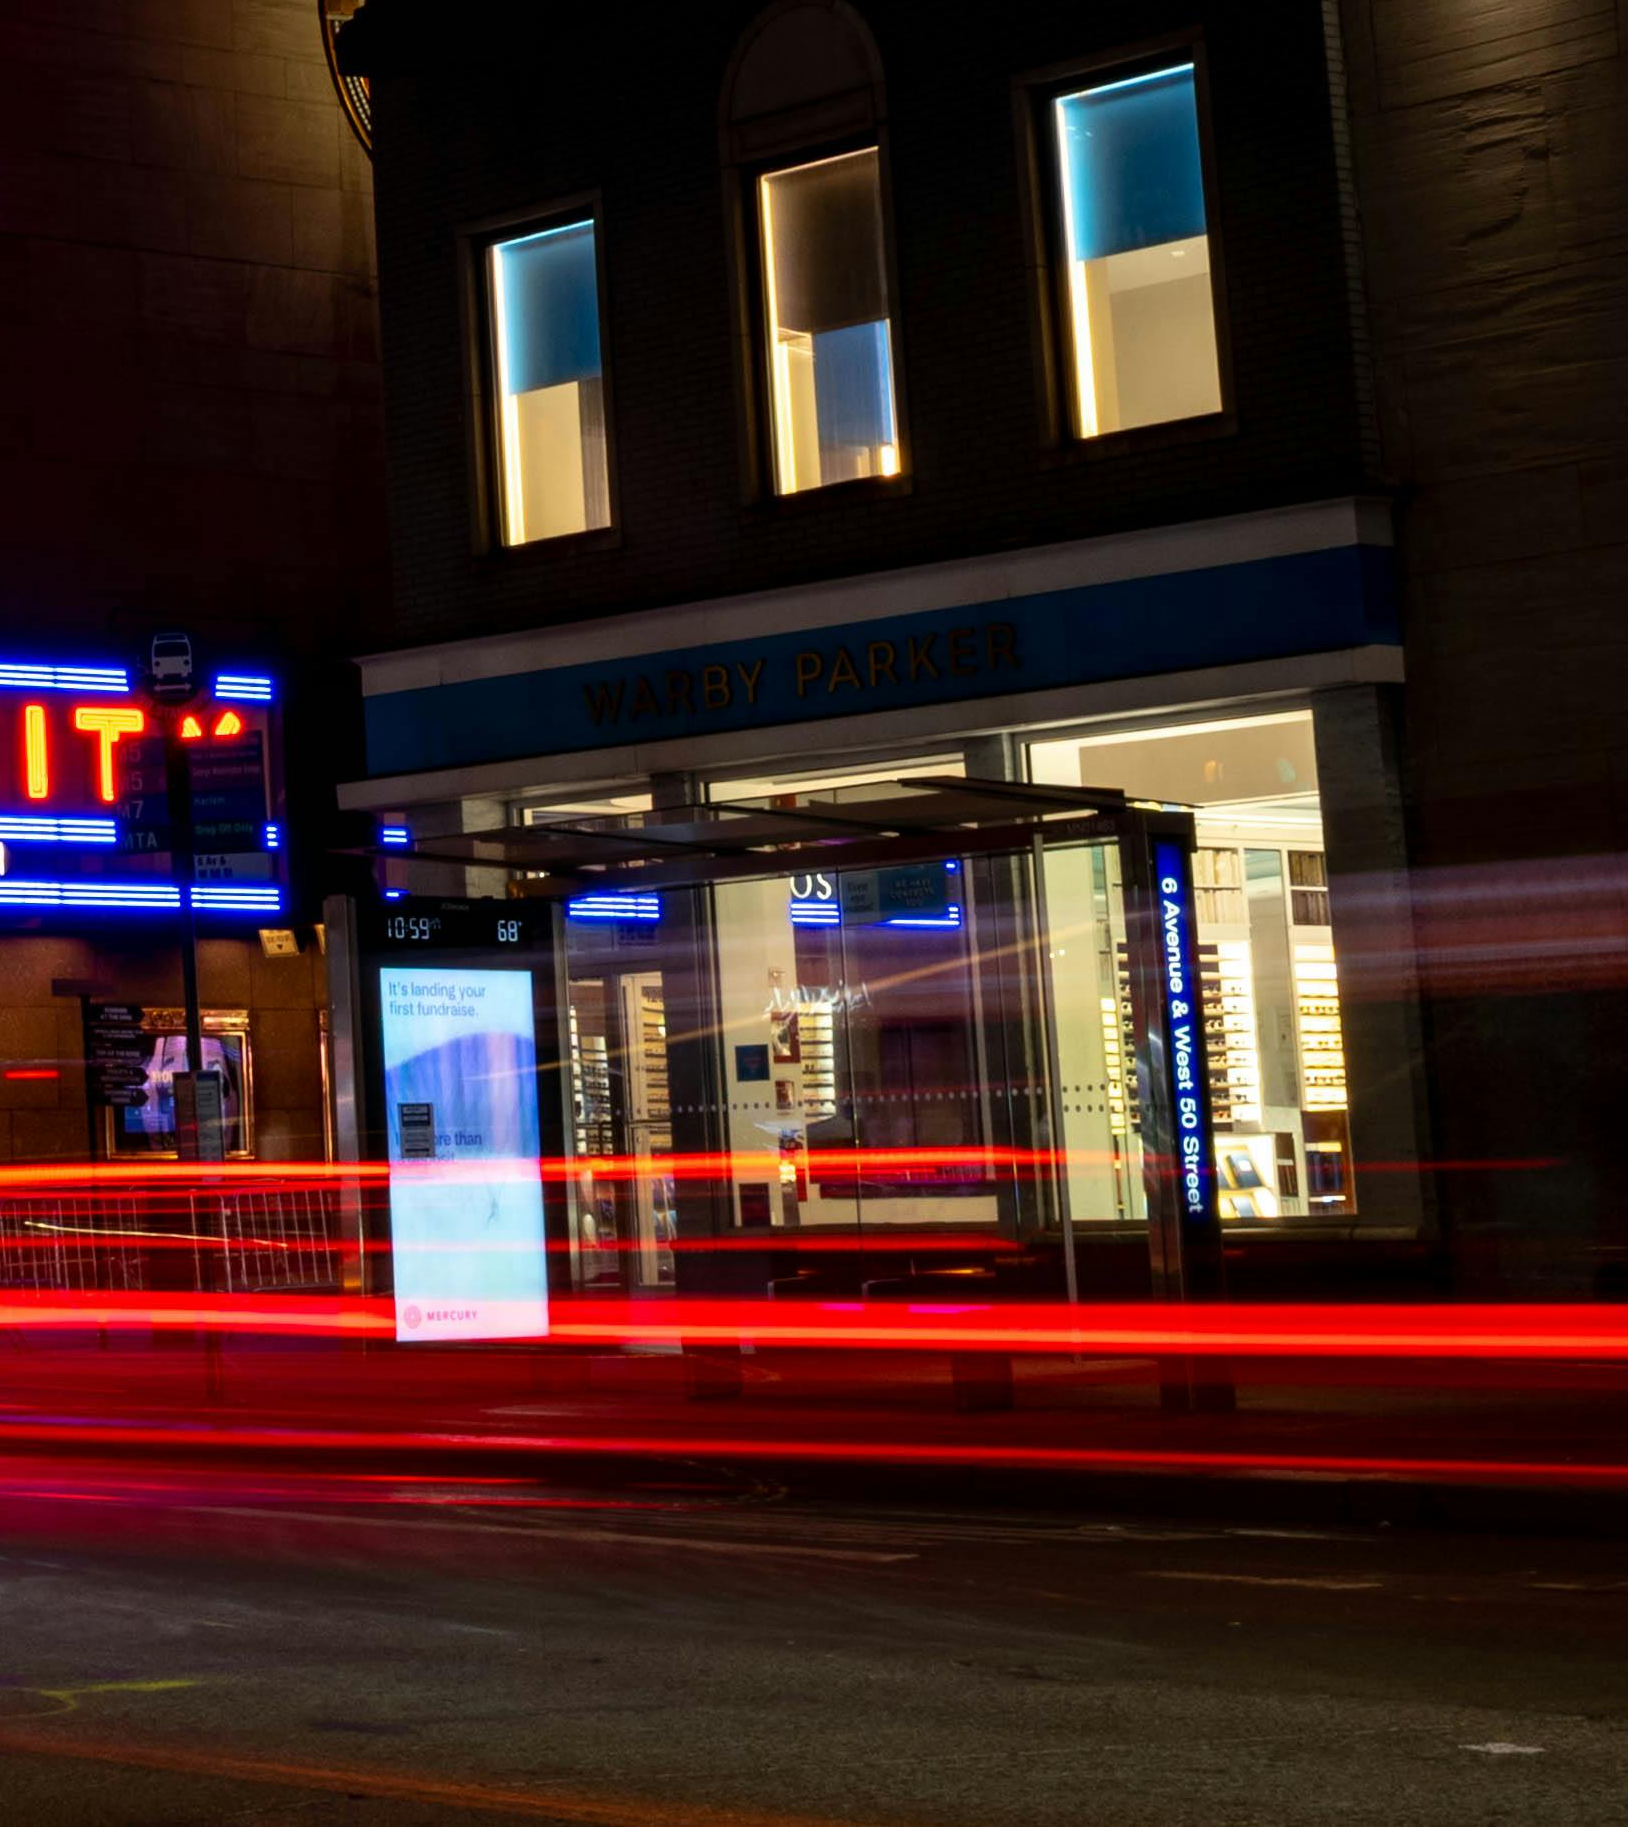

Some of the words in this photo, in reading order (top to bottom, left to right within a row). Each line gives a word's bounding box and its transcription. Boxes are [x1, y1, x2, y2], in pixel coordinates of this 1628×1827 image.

[584, 657, 767, 727] WARBY
[794, 622, 1021, 699] PARKER
[1161, 876, 1178, 894] 6
[1162, 900, 1183, 994] Avenue
[388, 981, 409, 997] It's
[411, 981, 456, 1000] landing
[458, 986, 486, 1001] your
[389, 1002, 414, 1016] first
[417, 1002, 479, 1017] fundraise.
[1171, 1001, 1189, 1020] &
[1174, 1024, 1195, 1092] West
[1179, 1097, 1198, 1130] 50
[454, 1131, 482, 1146] than
[1183, 1135, 1203, 1214] Street
[426, 1309, 478, 1322] MERCURY
